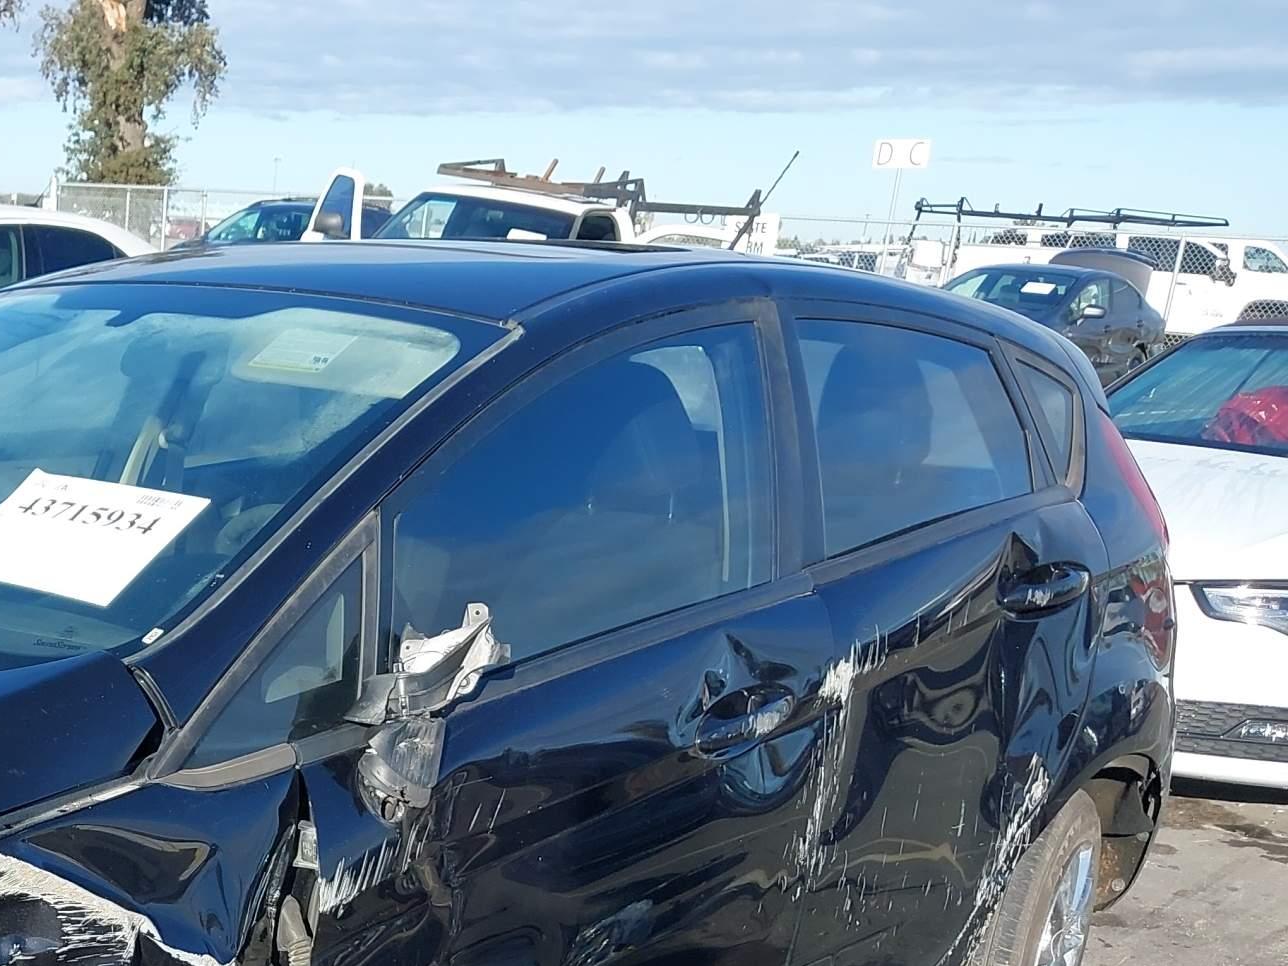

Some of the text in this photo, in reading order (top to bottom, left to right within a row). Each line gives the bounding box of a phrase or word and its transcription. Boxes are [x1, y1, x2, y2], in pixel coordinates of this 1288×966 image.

[876, 141, 925, 166] D C
[734, 220, 768, 234] STE
[18, 497, 162, 535] 43715934
